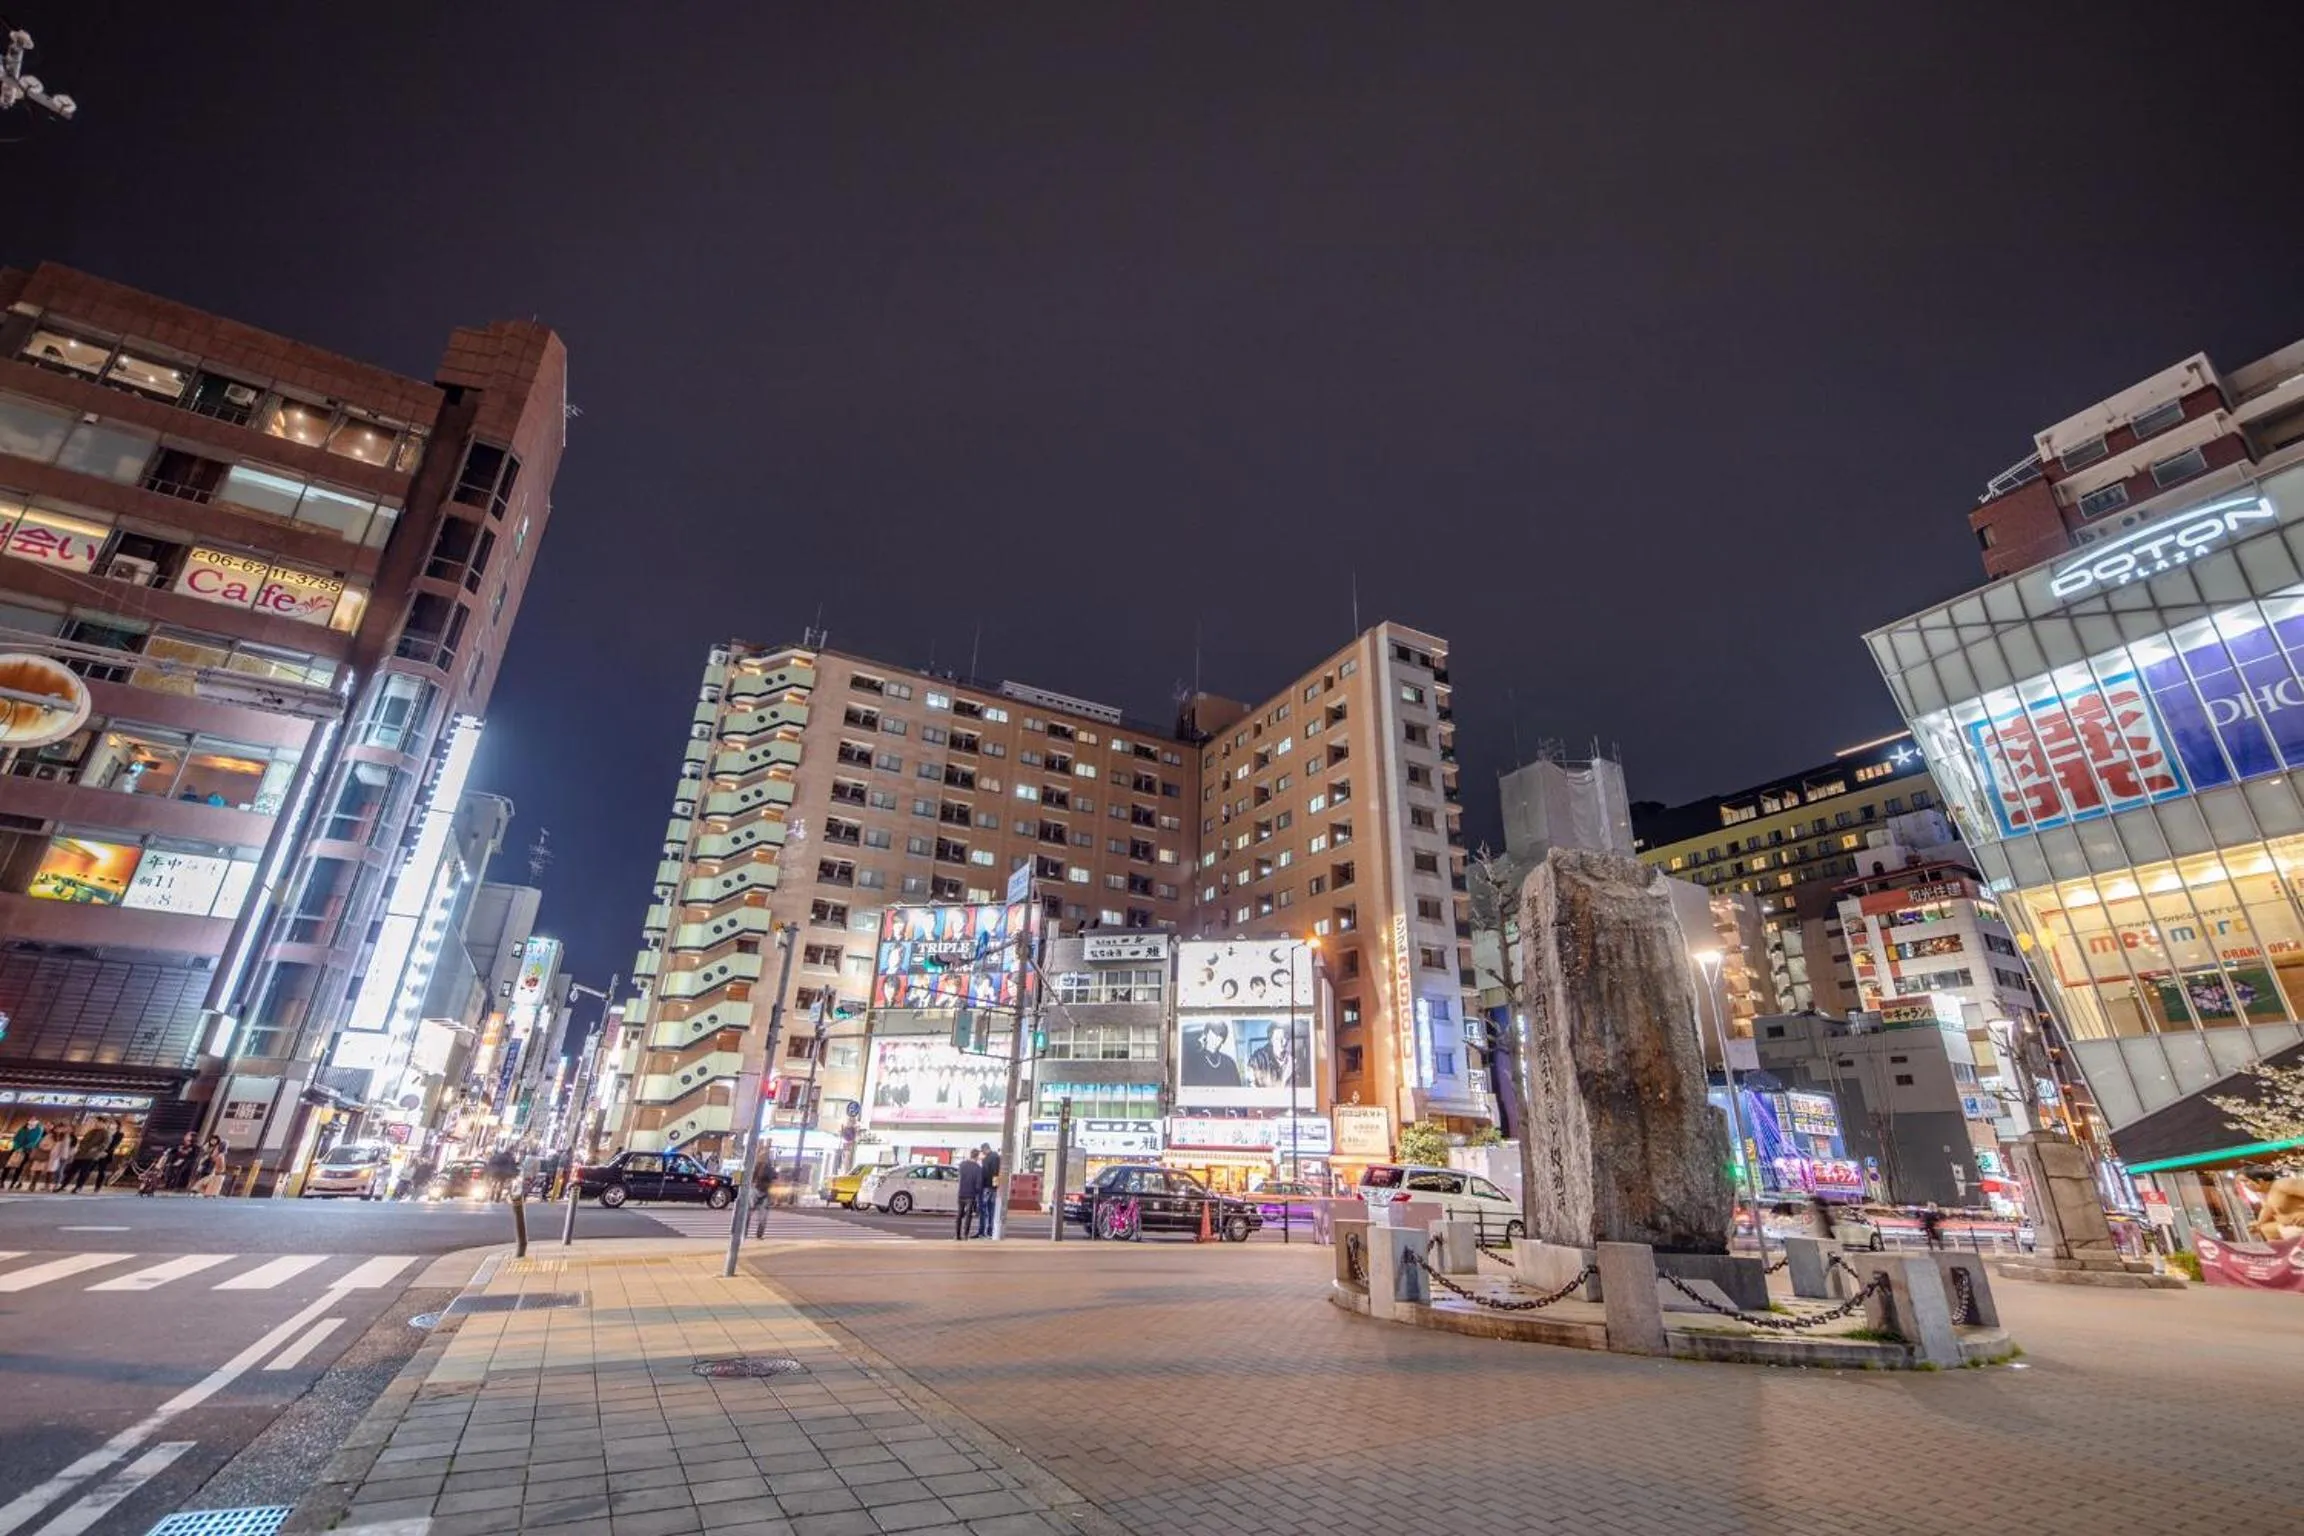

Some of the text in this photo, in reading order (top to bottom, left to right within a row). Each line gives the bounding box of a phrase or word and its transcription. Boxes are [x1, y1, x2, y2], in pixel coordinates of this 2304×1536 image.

[2050, 496, 2274, 598] DOTON
[2117, 544, 2209, 585] PLAZA
[187, 568, 297, 612] Cafe
[2204, 676, 2304, 727] DHC
[917, 942, 970, 953] TRIPLE
